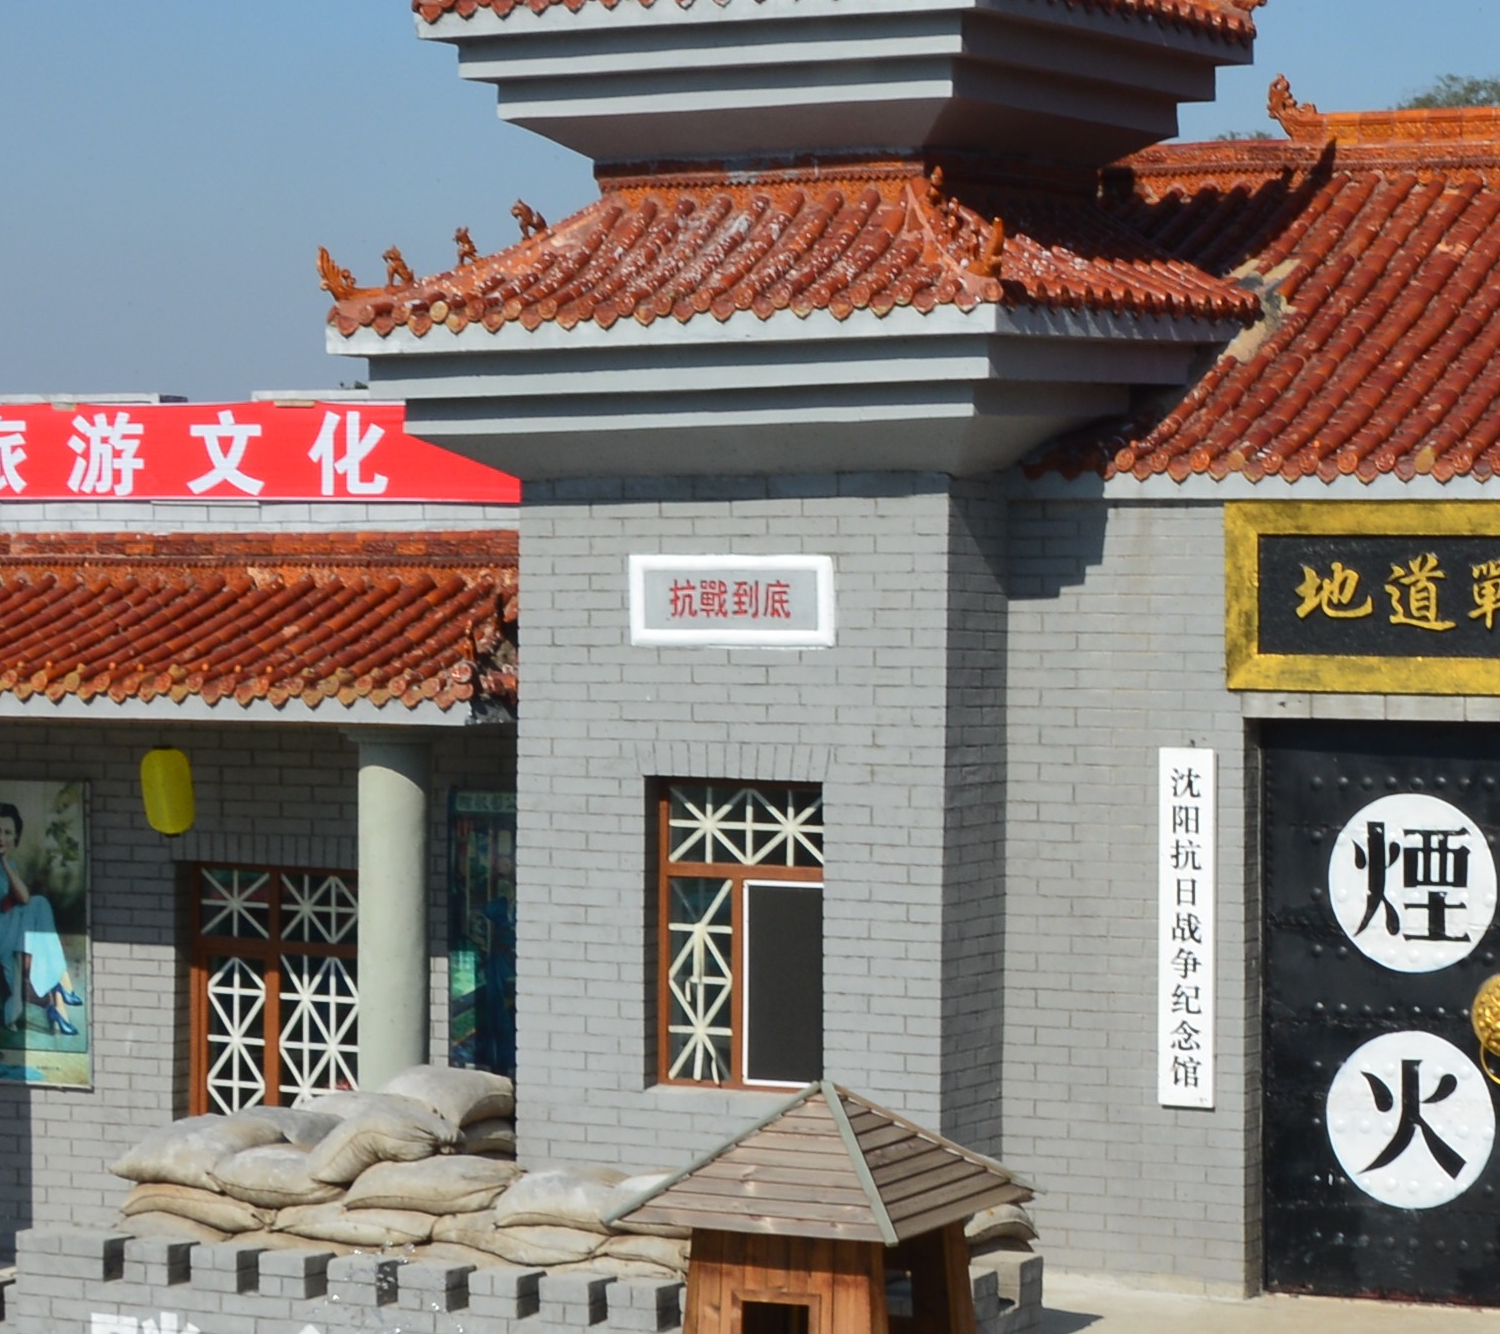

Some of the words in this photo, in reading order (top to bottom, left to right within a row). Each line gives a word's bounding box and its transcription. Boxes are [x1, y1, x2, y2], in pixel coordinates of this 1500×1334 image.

[669, 579, 792, 619] 抗戰到底
[1170, 767, 1202, 1088] 沈阳抗日战争纪念馆
